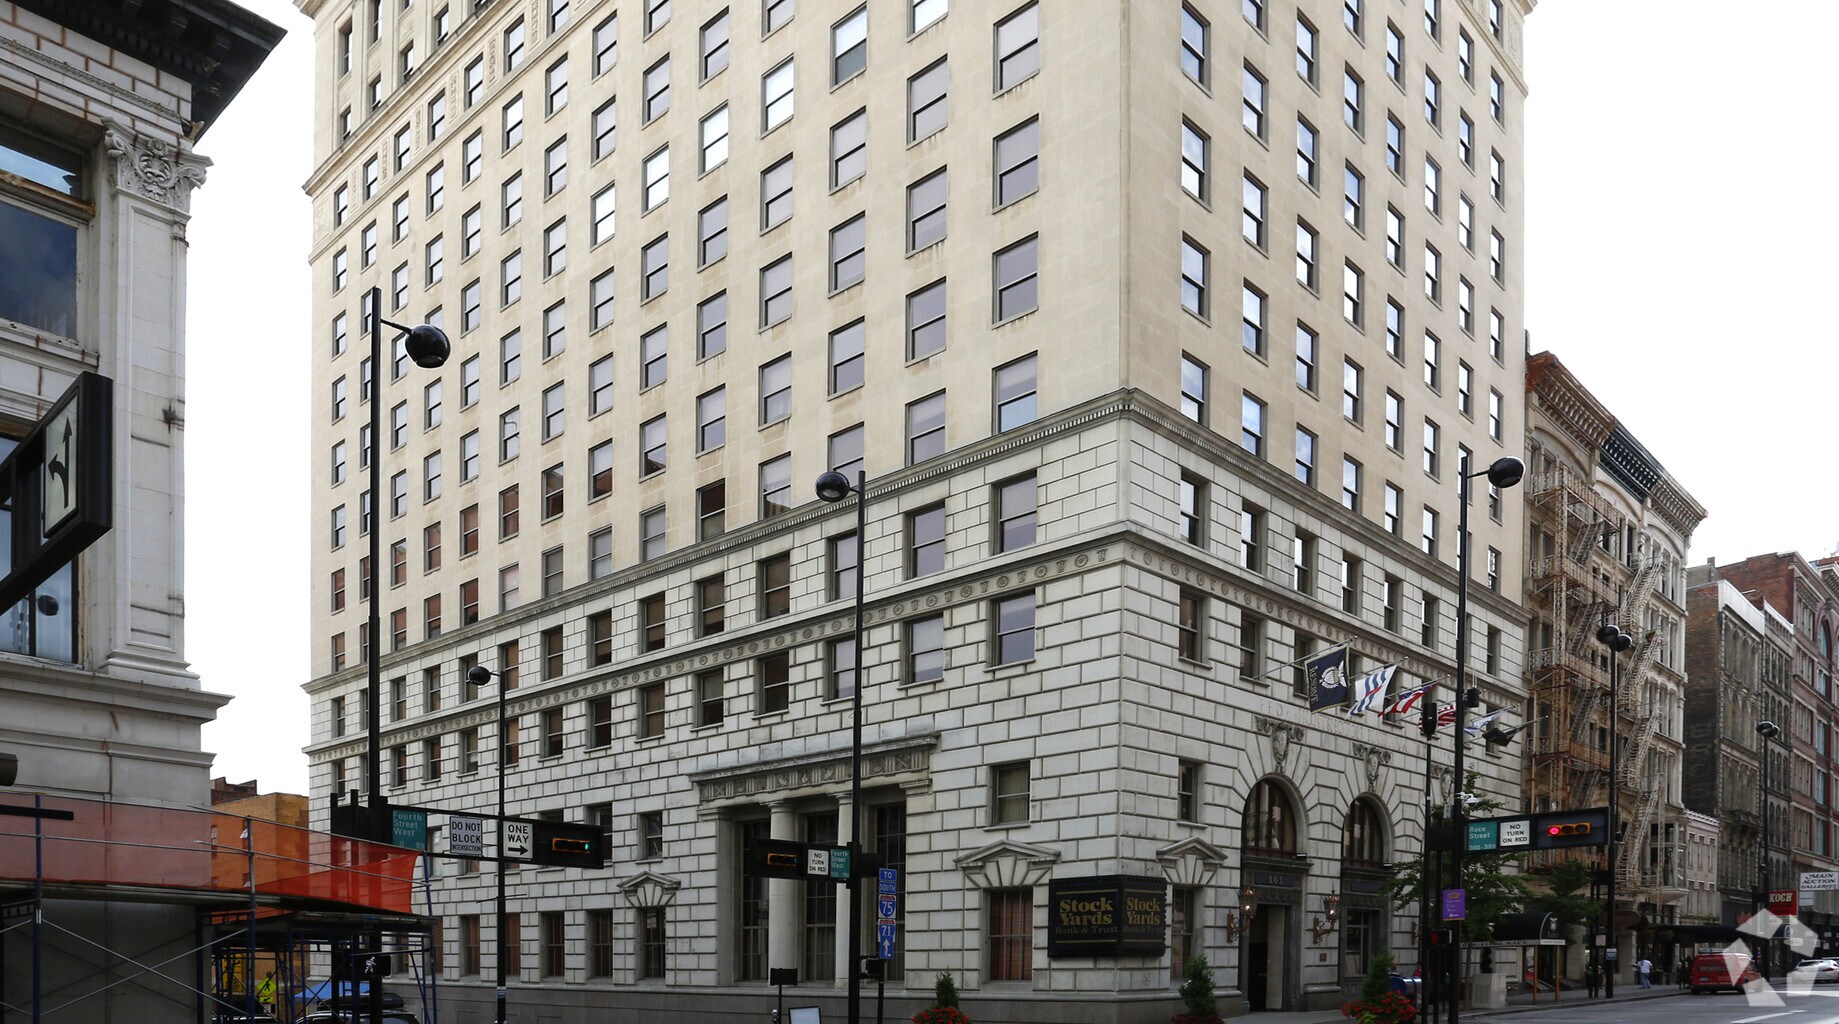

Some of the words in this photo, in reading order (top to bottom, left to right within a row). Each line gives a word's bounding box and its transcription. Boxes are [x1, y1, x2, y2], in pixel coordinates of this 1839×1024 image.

[393, 811, 422, 821] Fourth
[393, 819, 418, 829] Street
[451, 821, 463, 831] DO
[465, 822, 481, 832] NOT
[393, 827, 415, 837] West
[508, 824, 529, 835] ONE
[452, 833, 481, 844] BLOCK
[508, 834, 529, 844] WAY
[1469, 832, 1490, 840] Street
[451, 844, 481, 852] INTERSECTION
[883, 871, 893, 879] TO
[1268, 874, 1283, 885] 101
[880, 883, 896, 891] SOUTH
[1769, 892, 1793, 902] KOCH
[882, 901, 893, 915] 75
[1059, 897, 1114, 913] Stock
[1126, 896, 1161, 912] Stock
[1059, 911, 1113, 926] Yards
[1126, 910, 1160, 925] Yards
[882, 925, 891, 936] 71
[1055, 926, 1079, 935] Bank
[1081, 926, 1089, 934] &
[1091, 925, 1118, 934] Trust
